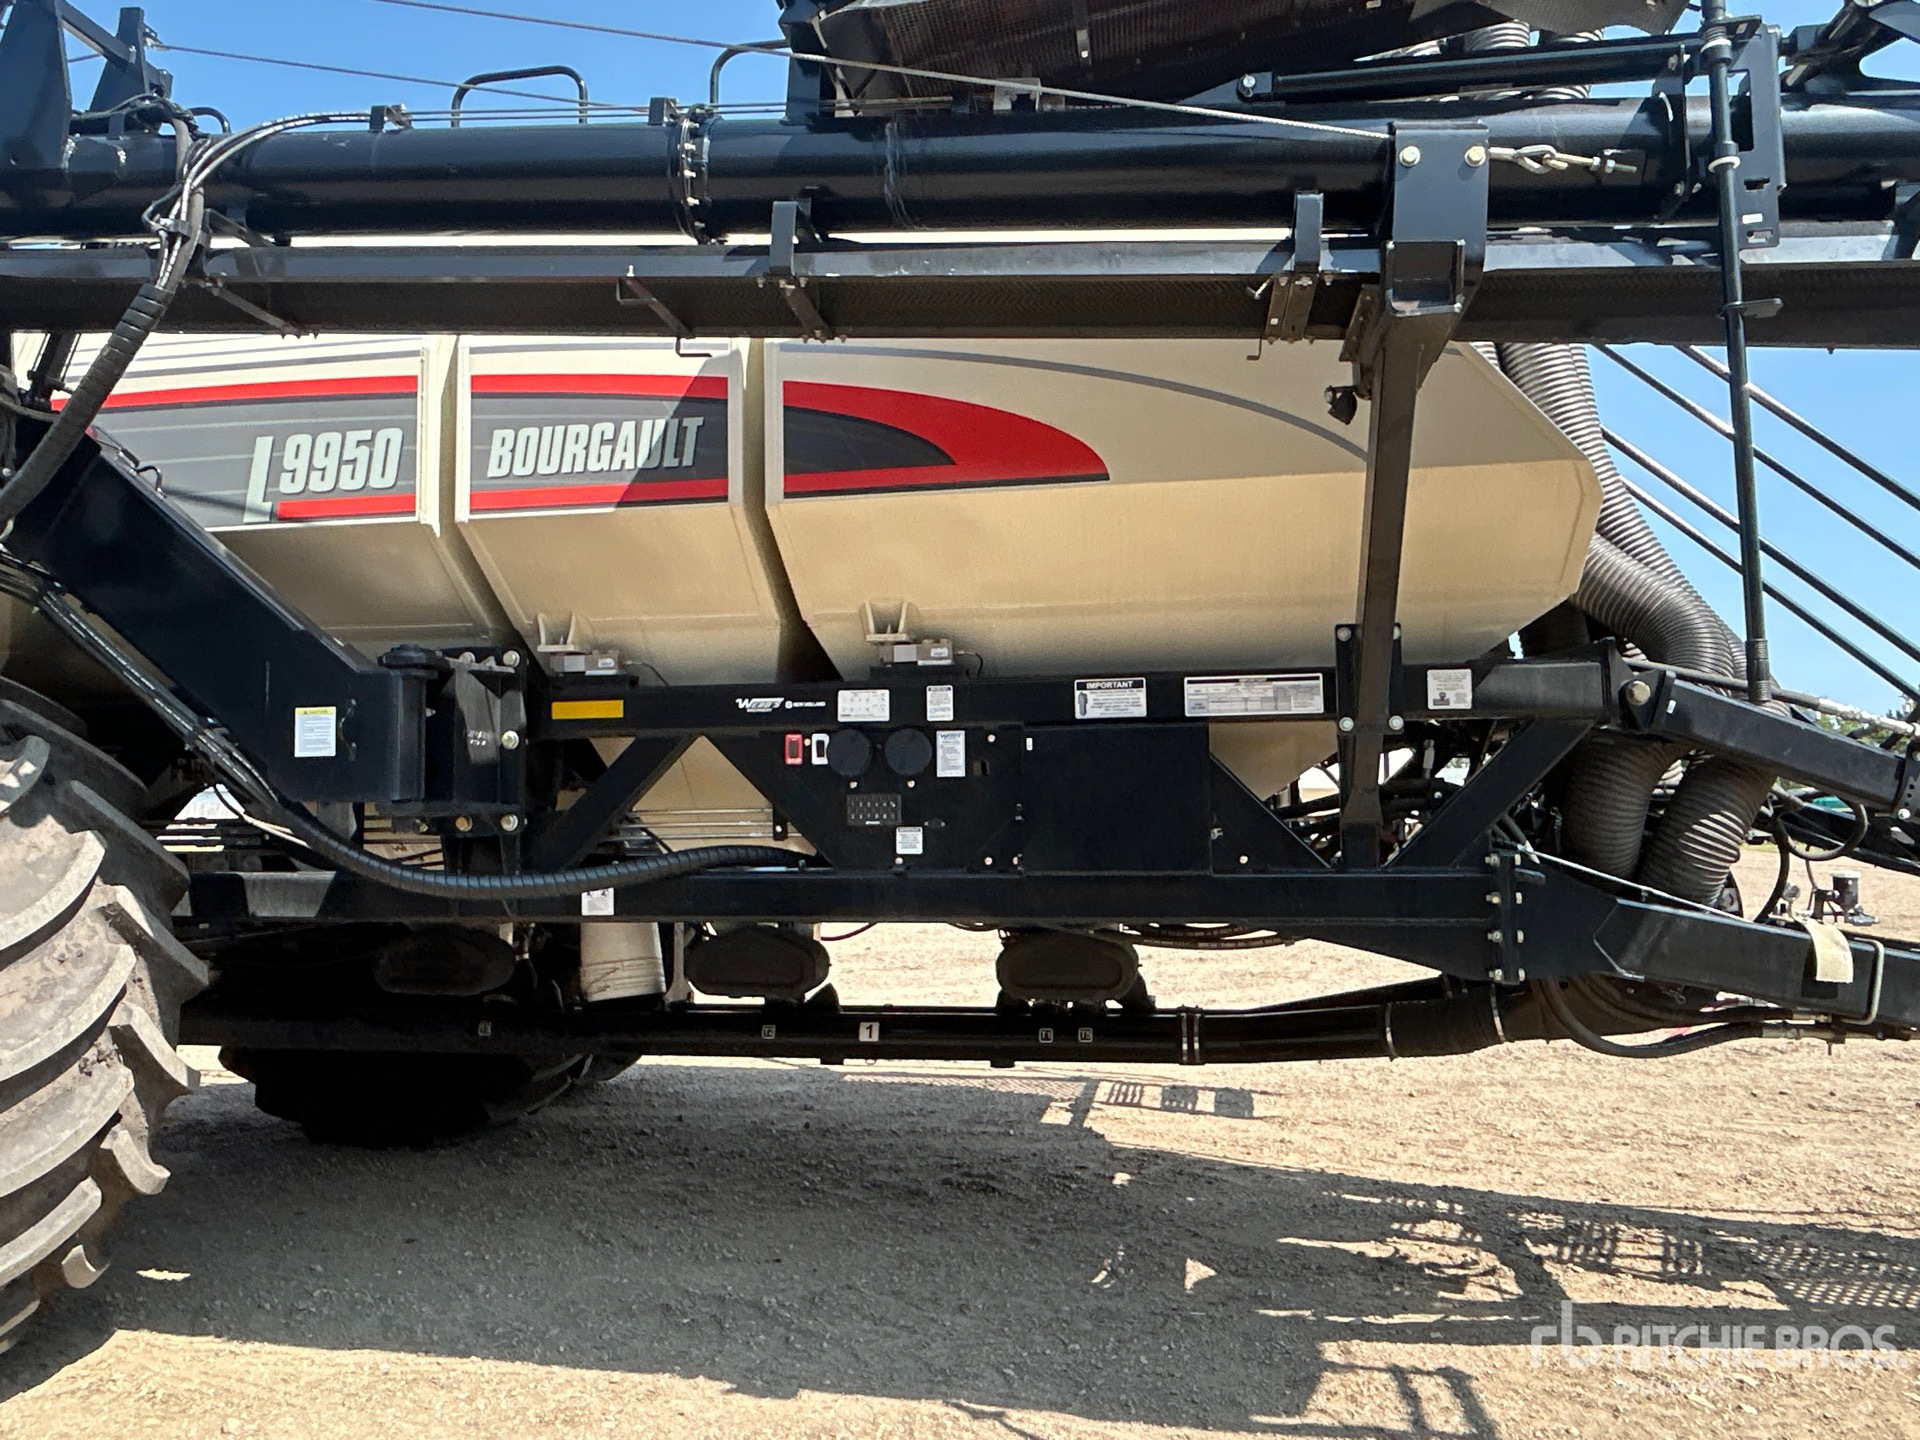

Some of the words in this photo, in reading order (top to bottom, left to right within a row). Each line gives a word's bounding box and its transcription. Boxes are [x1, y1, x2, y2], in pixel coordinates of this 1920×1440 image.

[487, 416, 705, 478] BOURGAULT
[244, 428, 404, 523] L9950
[1086, 680, 1134, 690] IMPORTANT
[865, 1023, 873, 1039] 1
